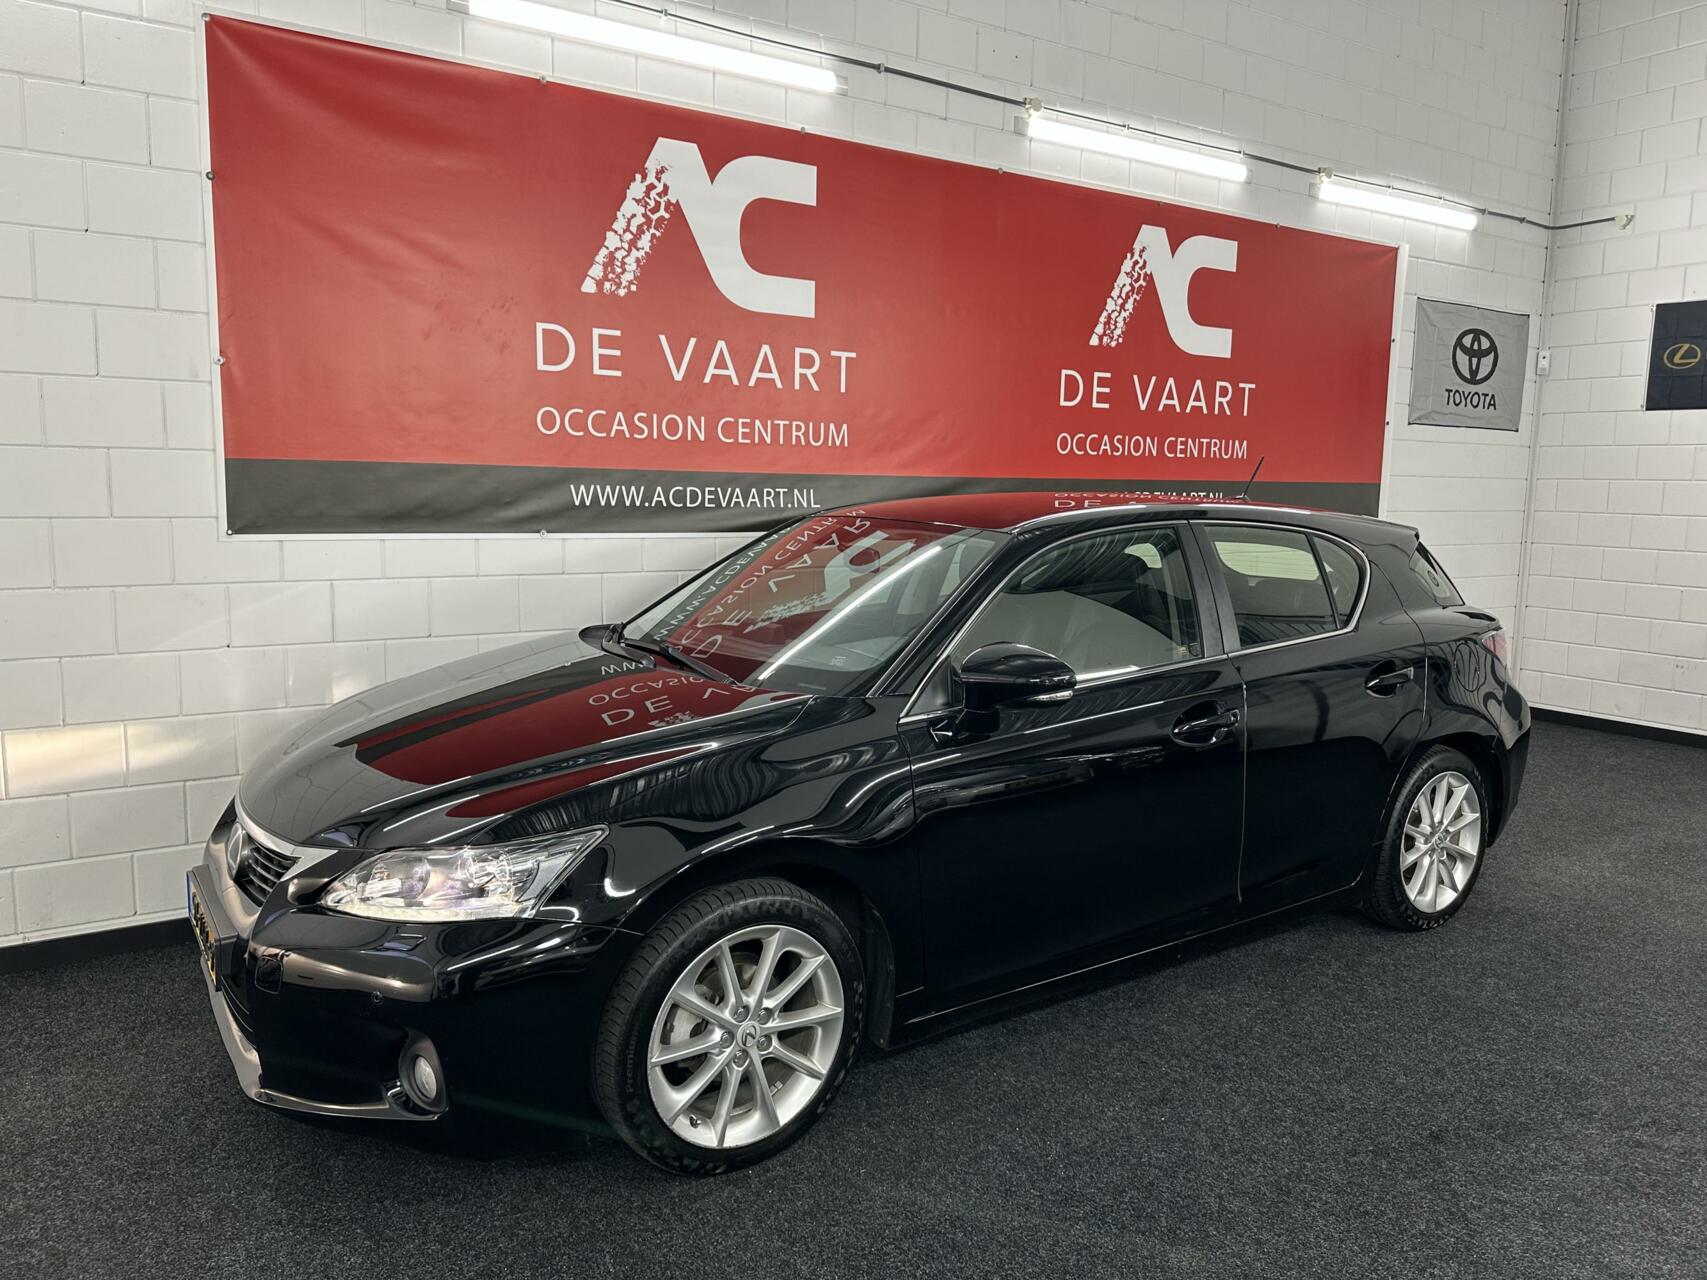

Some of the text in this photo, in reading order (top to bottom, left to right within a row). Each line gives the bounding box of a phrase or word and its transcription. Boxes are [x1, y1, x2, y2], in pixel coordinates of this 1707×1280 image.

[535, 321, 857, 392] DE VAART
[1059, 368, 1256, 417] DE VAART
[1445, 388, 1497, 411] TOYOTA
[536, 406, 849, 447] OCCASION CENTRUM
[1056, 432, 1248, 460] OCCASION CENTRUM
[570, 483, 821, 508] WWW.ACDEVAART.NL
